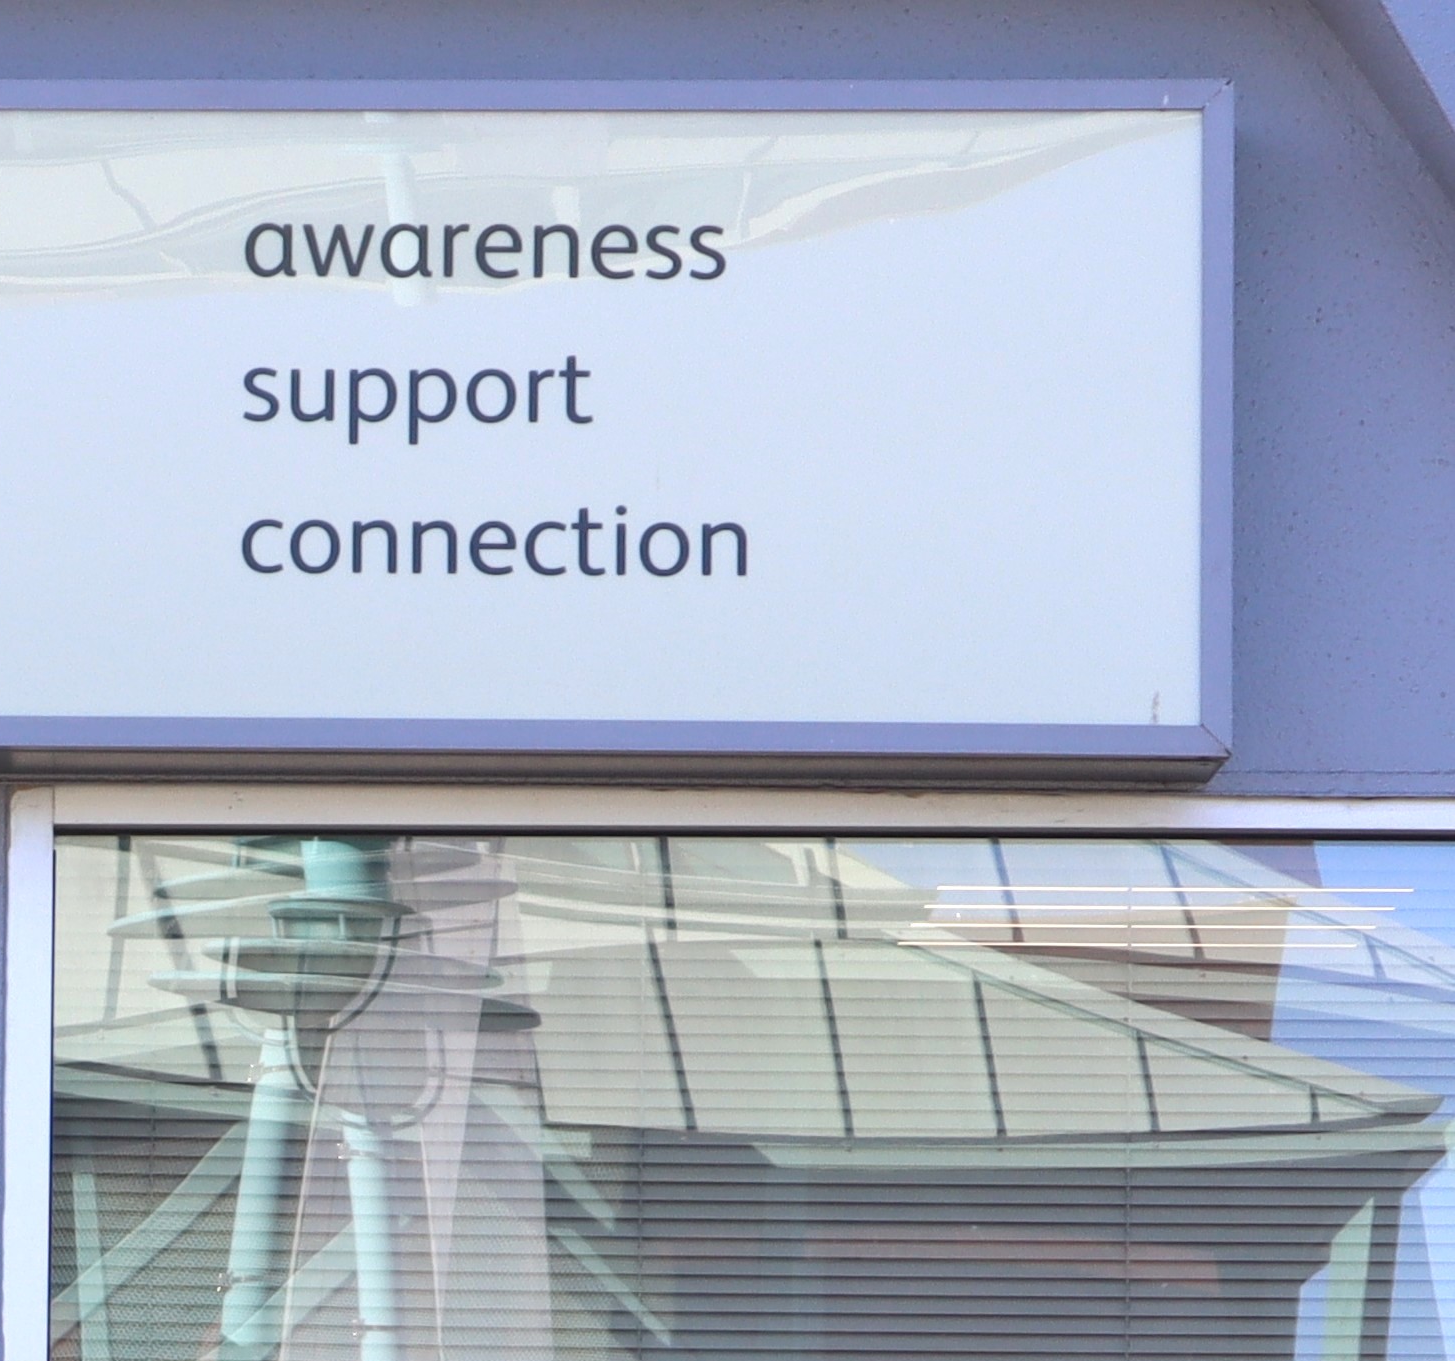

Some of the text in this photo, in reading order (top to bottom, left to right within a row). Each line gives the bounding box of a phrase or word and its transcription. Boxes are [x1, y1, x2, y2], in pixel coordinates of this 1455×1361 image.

[244, 223, 726, 281] awareness
[243, 355, 593, 446] support
[241, 505, 747, 577] connection
